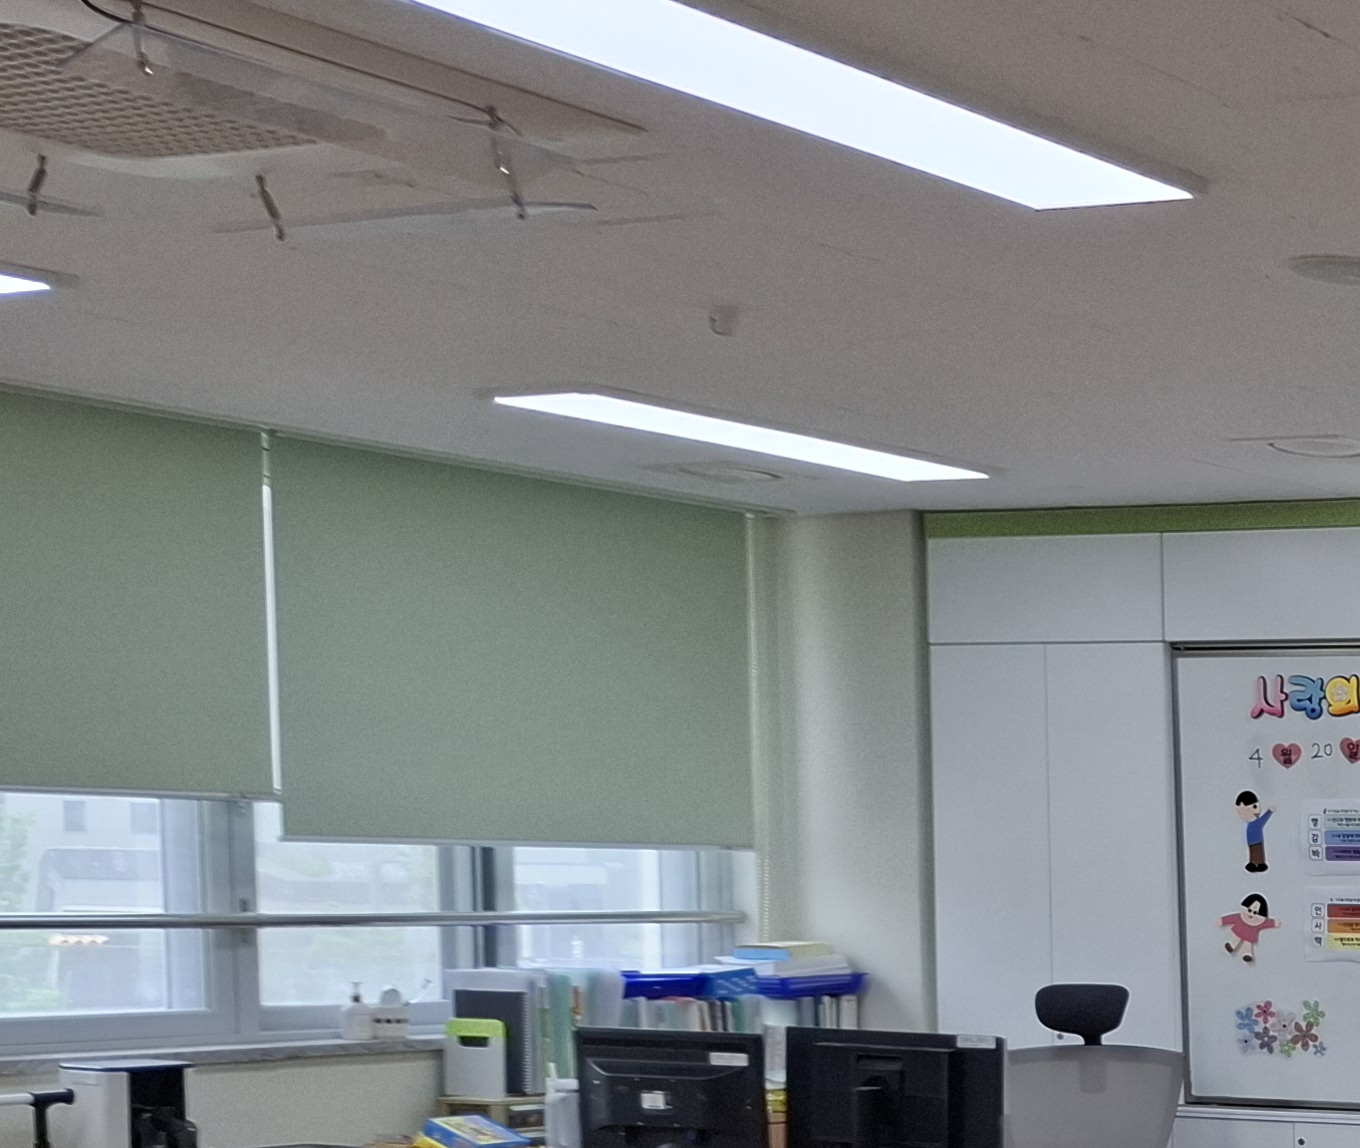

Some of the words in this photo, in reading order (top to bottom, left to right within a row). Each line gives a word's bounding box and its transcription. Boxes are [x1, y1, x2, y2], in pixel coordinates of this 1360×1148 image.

[1249, 748, 1263, 768] 4
[1311, 743, 1333, 759] 20
[1346, 743, 1360, 760] 일
